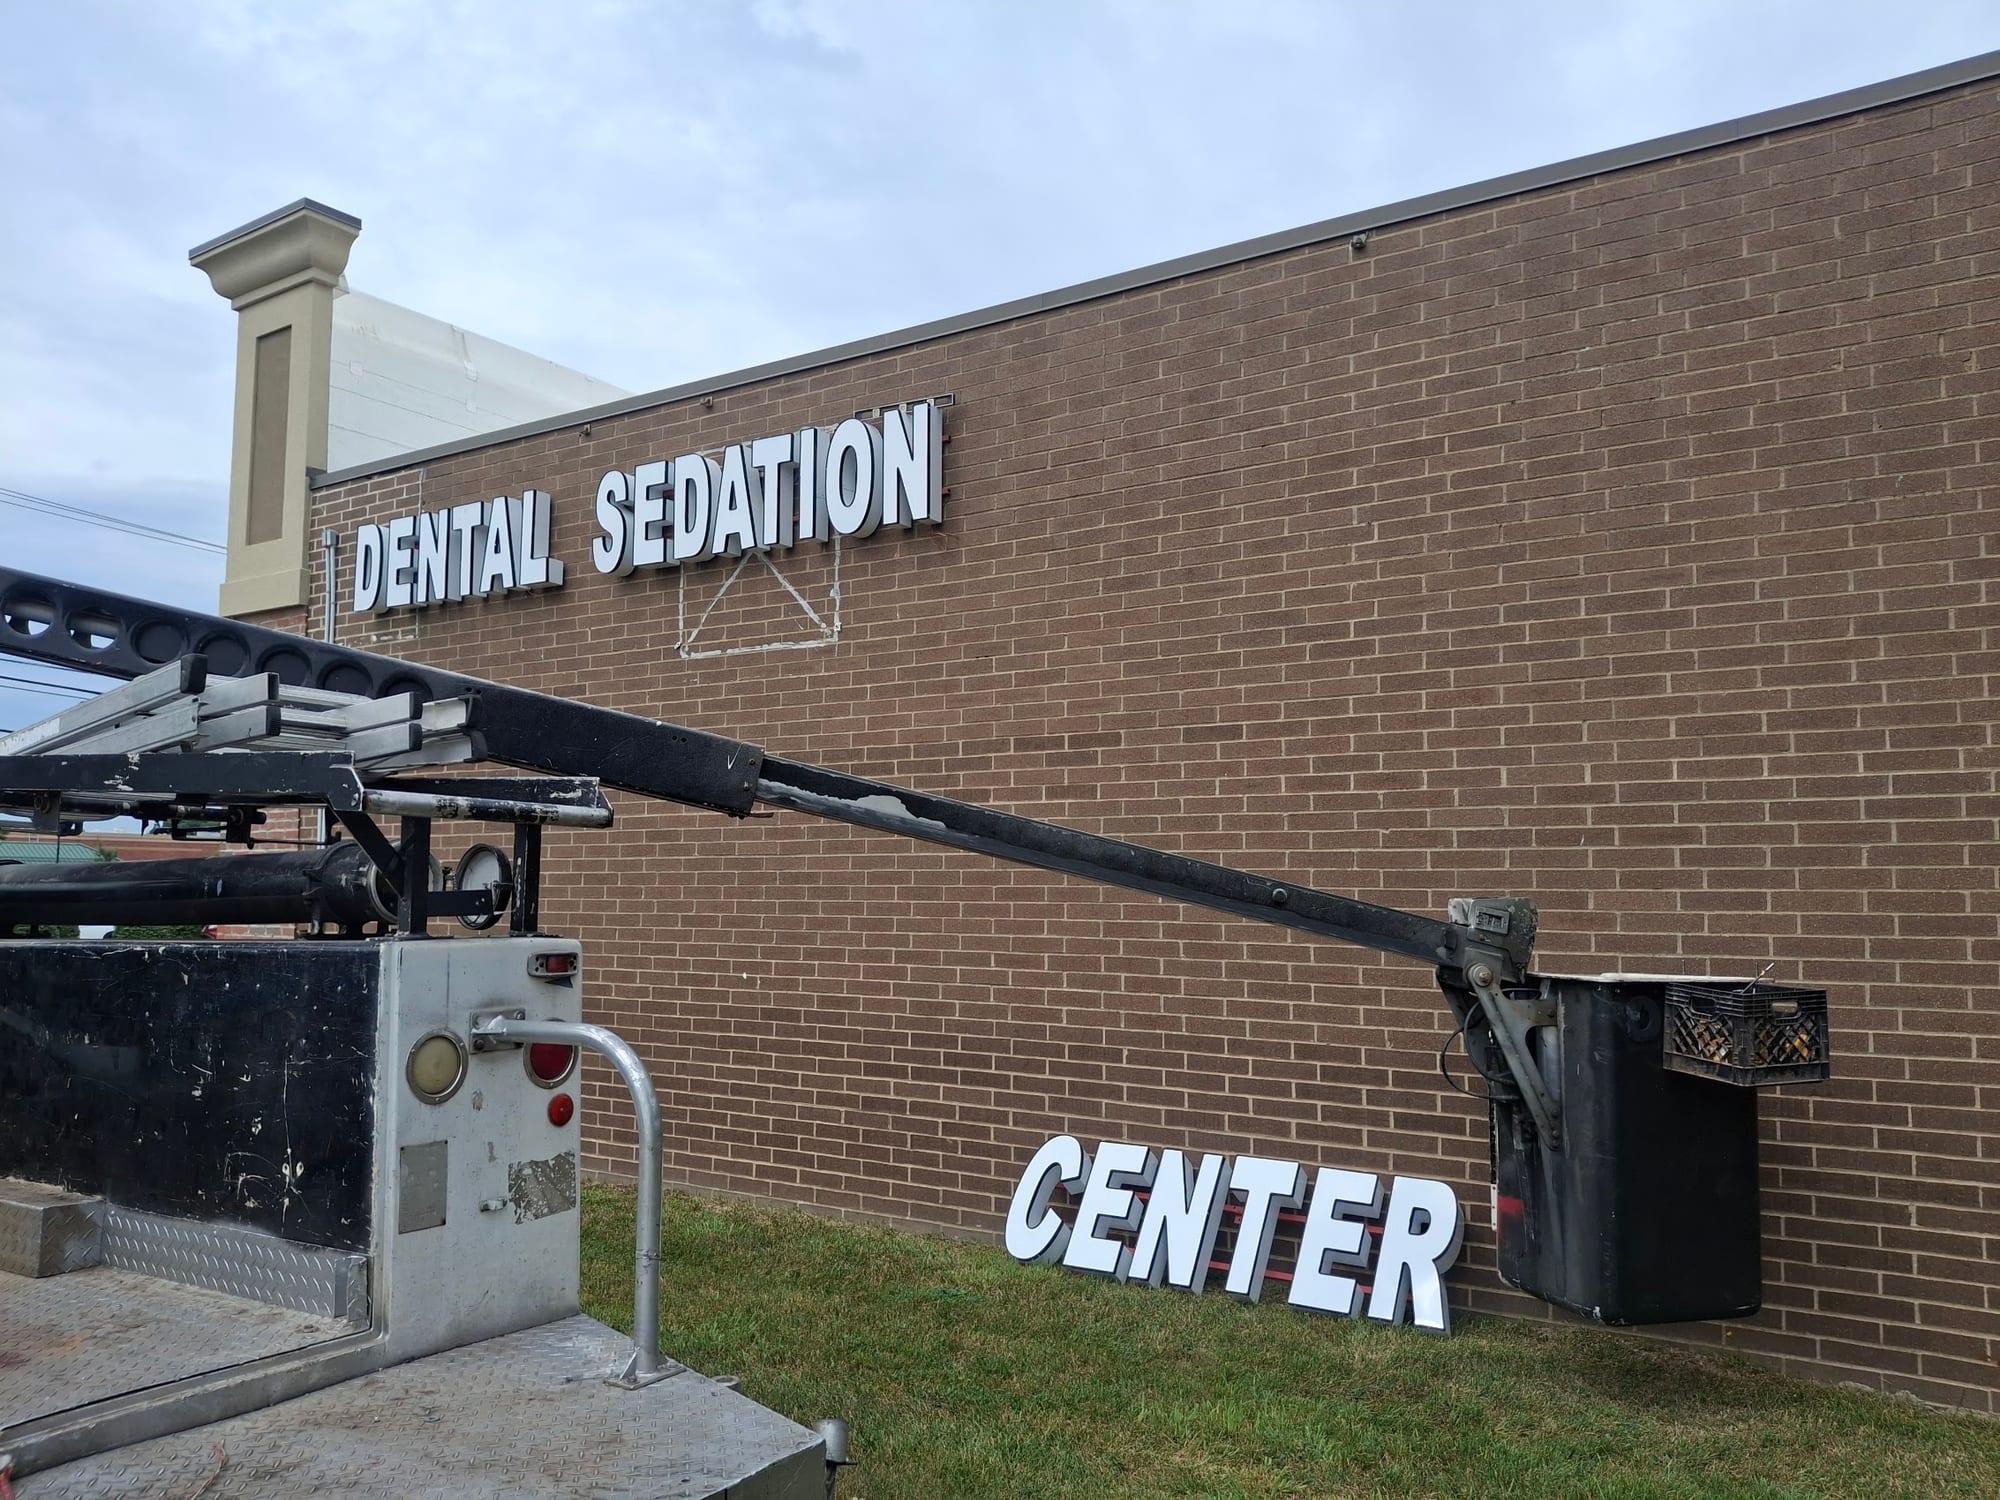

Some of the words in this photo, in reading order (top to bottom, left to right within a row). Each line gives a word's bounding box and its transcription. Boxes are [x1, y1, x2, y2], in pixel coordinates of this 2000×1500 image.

[354, 491, 563, 612] DENTAL
[592, 402, 942, 576] SEDATION
[1004, 1134, 1463, 1334] CENTER
